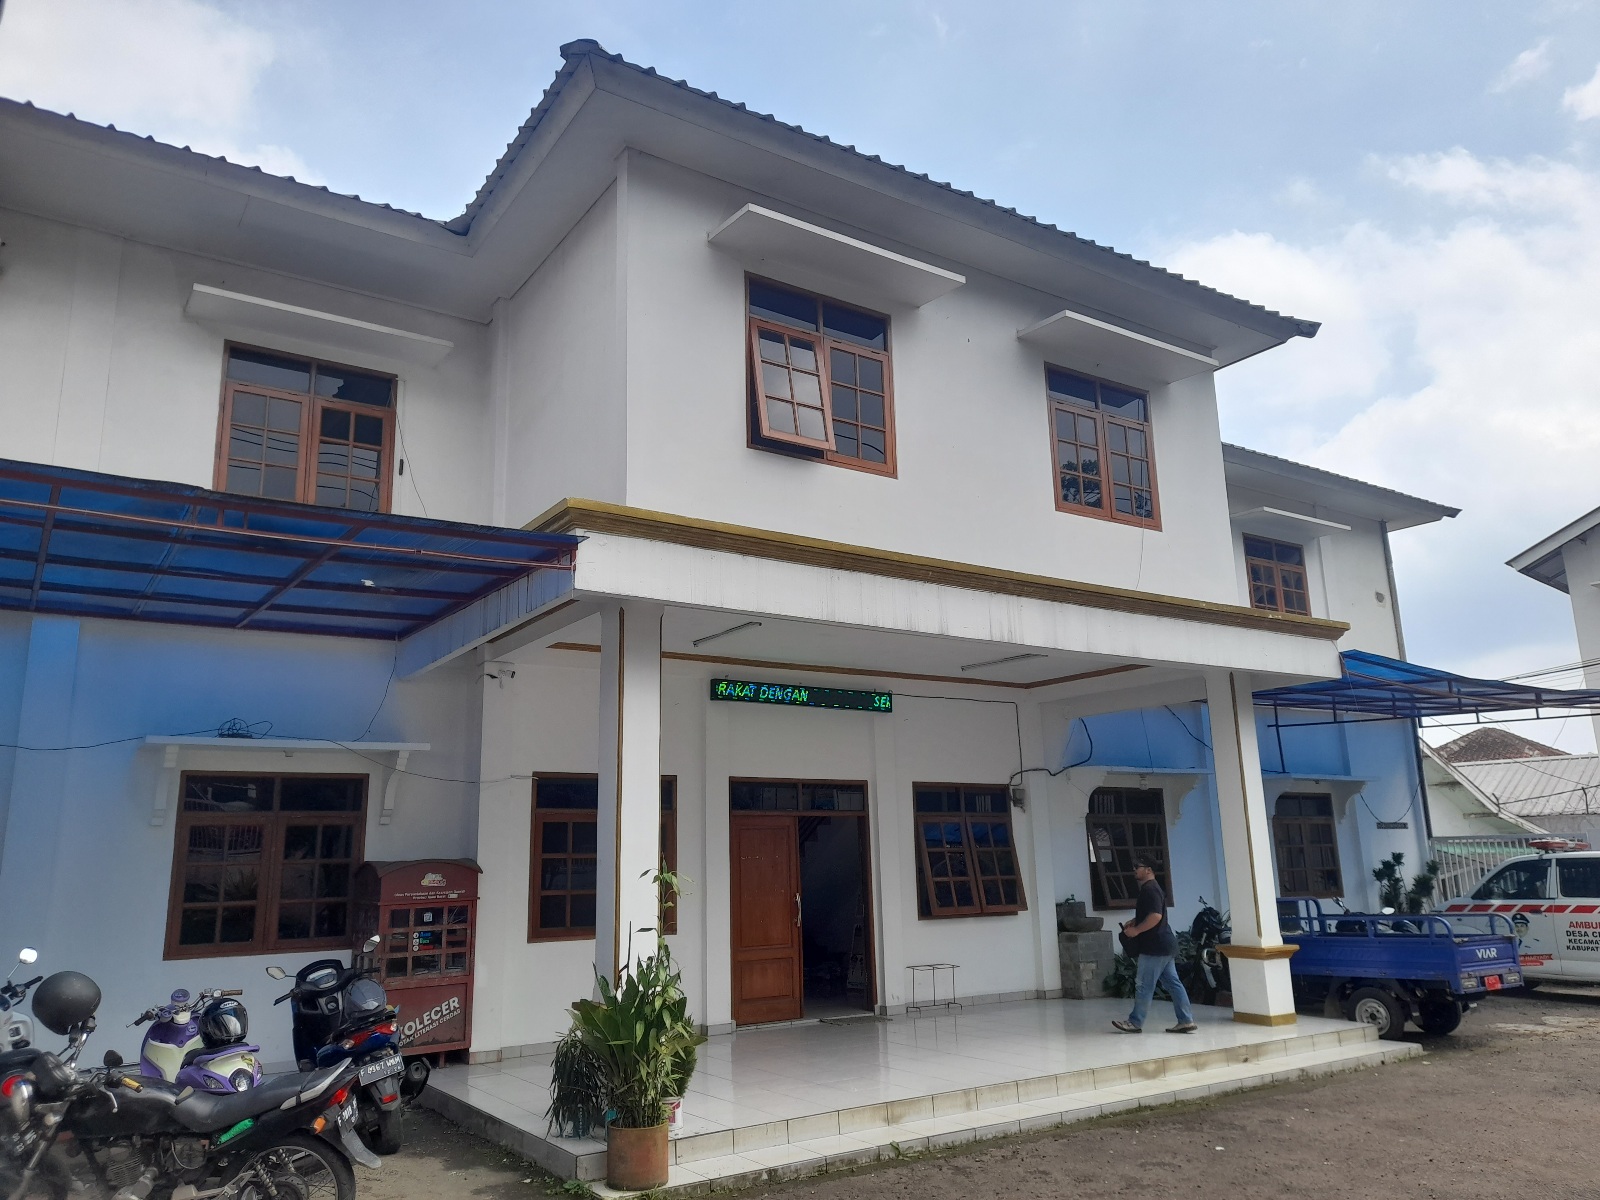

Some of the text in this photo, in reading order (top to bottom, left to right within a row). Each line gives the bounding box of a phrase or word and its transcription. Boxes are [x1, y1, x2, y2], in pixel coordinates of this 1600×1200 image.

[760, 684, 809, 702] DENGAN
[1565, 930, 1590, 938] DESA
[1475, 947, 1498, 959] VIAR
[414, 1020, 439, 1039] LITERASI
